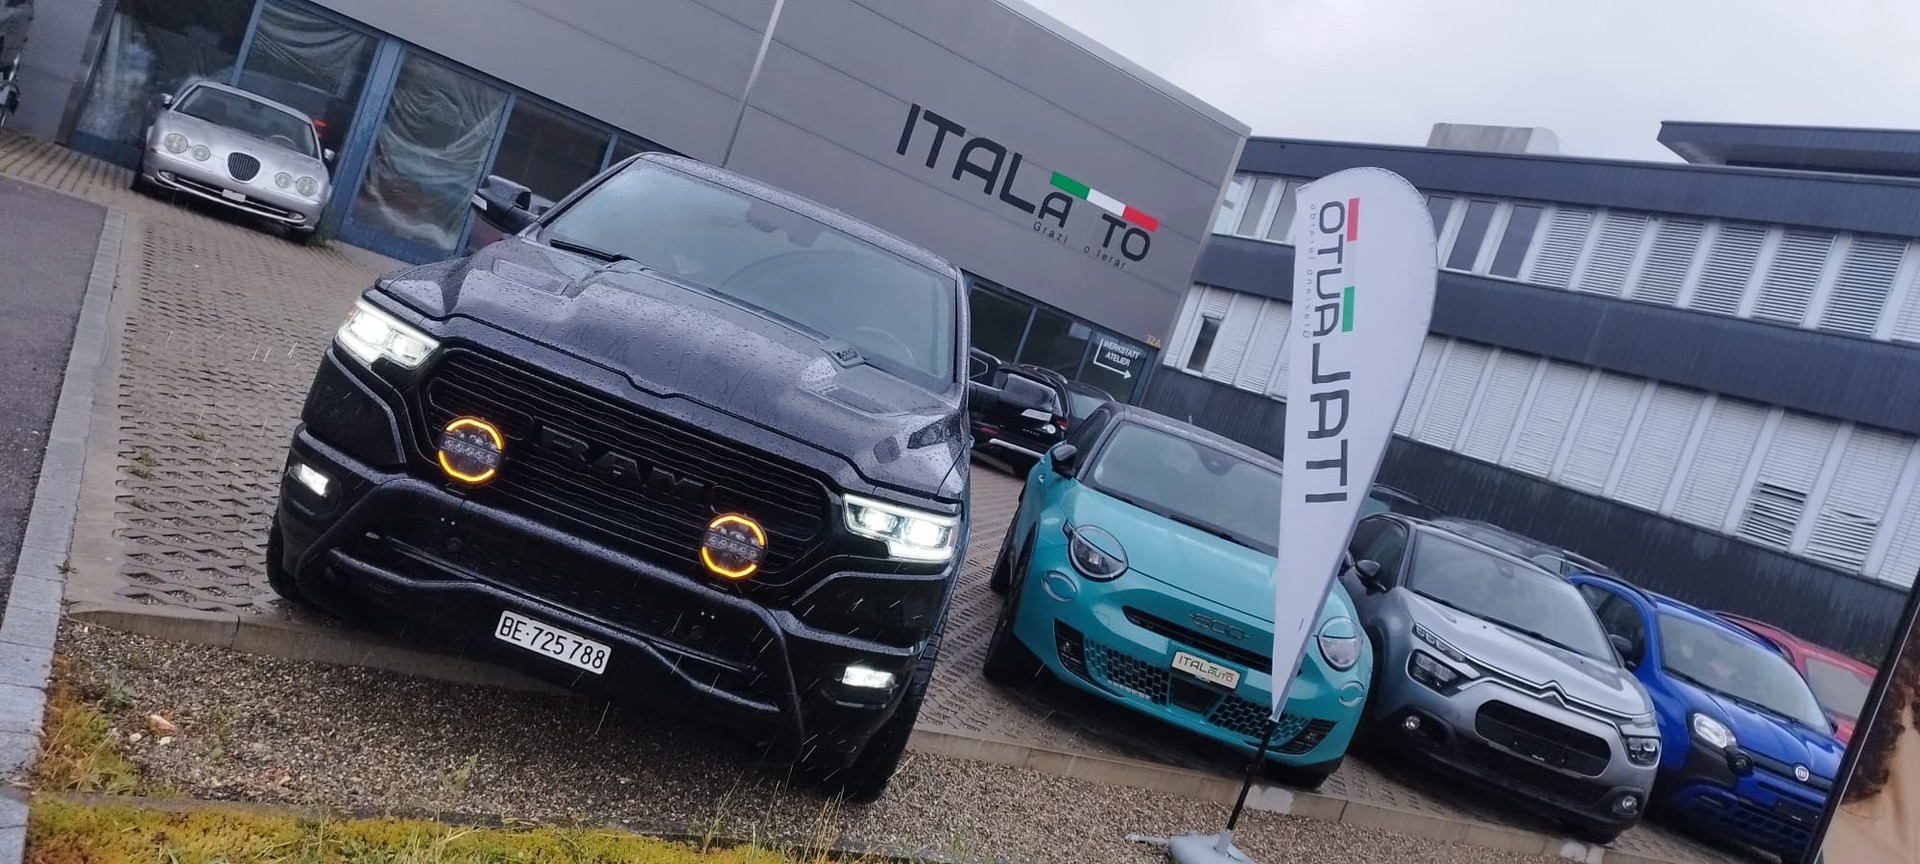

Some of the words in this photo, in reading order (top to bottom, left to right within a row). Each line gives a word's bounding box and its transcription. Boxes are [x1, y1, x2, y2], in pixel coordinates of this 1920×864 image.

[1104, 340, 1139, 359] WERKSTATT
[1105, 351, 1131, 367] ATELIER
[538, 425, 704, 505] RAM
[1178, 655, 1234, 682] ITALAUTO
